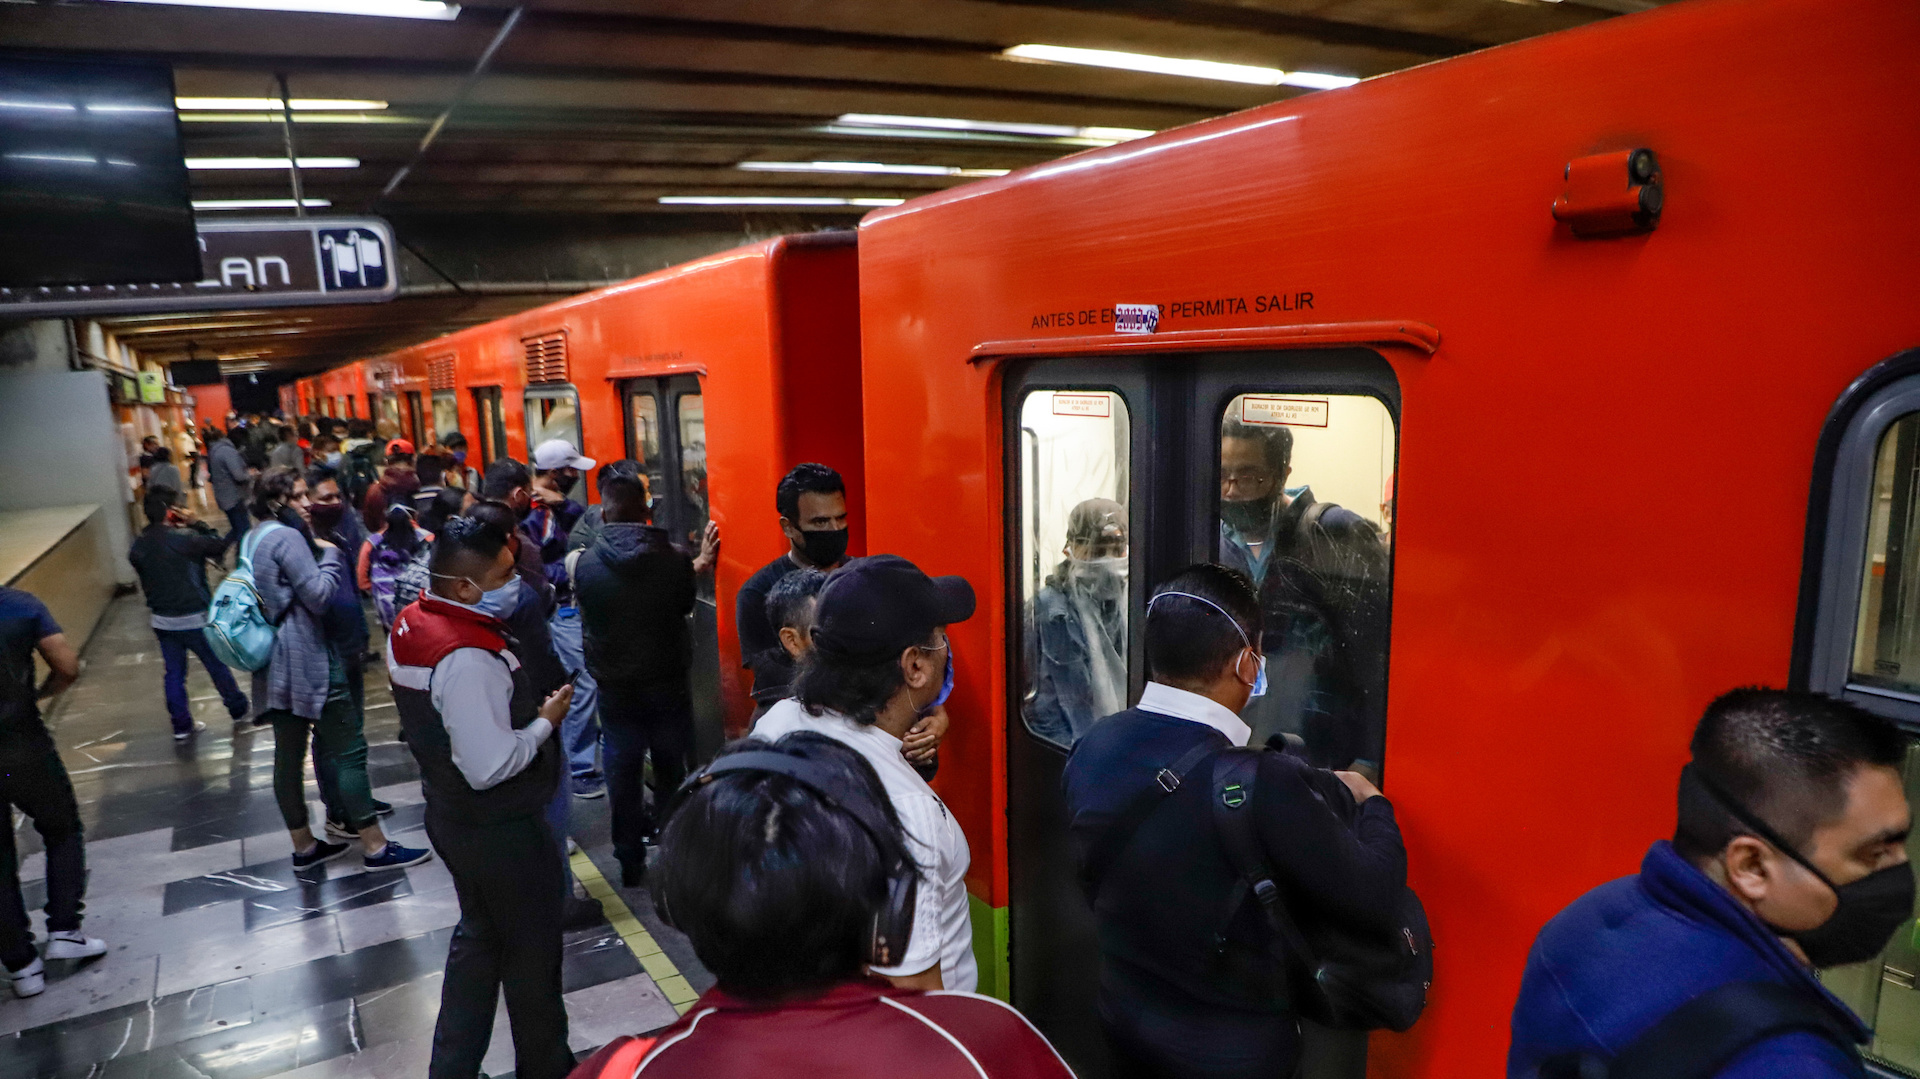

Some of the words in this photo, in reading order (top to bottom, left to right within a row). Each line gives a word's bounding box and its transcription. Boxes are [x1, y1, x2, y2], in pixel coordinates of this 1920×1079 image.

[1031, 310, 1075, 329] ANTES
[1078, 309, 1097, 326] DE
[1171, 298, 1248, 319] PERMITA
[1255, 292, 1315, 313] SALIR
